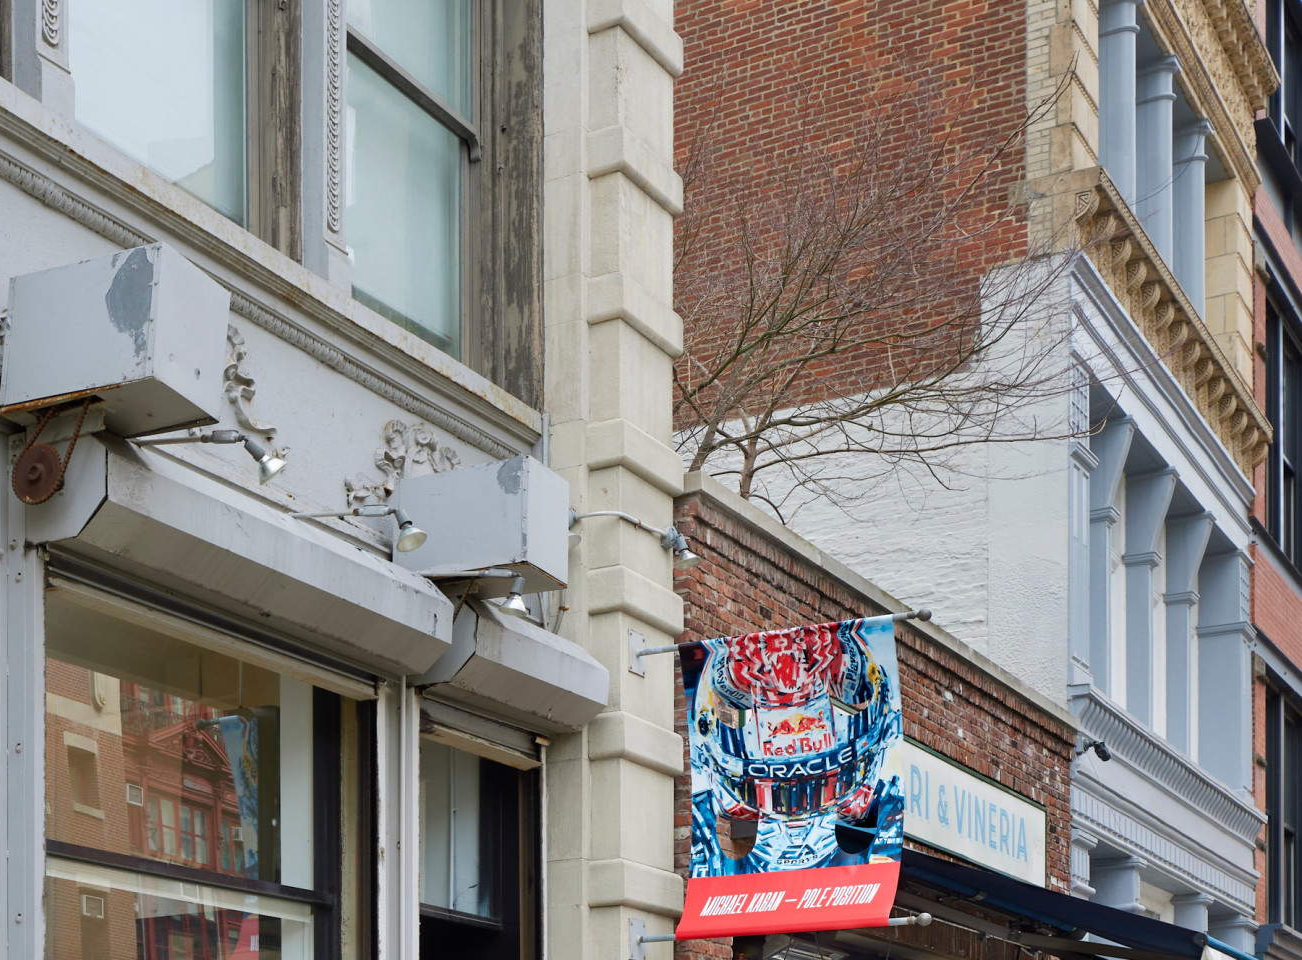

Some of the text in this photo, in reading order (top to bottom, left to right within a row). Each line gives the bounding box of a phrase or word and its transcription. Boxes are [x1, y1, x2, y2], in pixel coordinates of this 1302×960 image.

[763, 733, 831, 756] Red Bull
[748, 747, 853, 778] ORACLE
[937, 784, 1028, 863] & VINERIA
[699, 894, 748, 917] MICHAEL
[796, 887, 832, 909] POLE
[826, 883, 881, 907] POSITION
